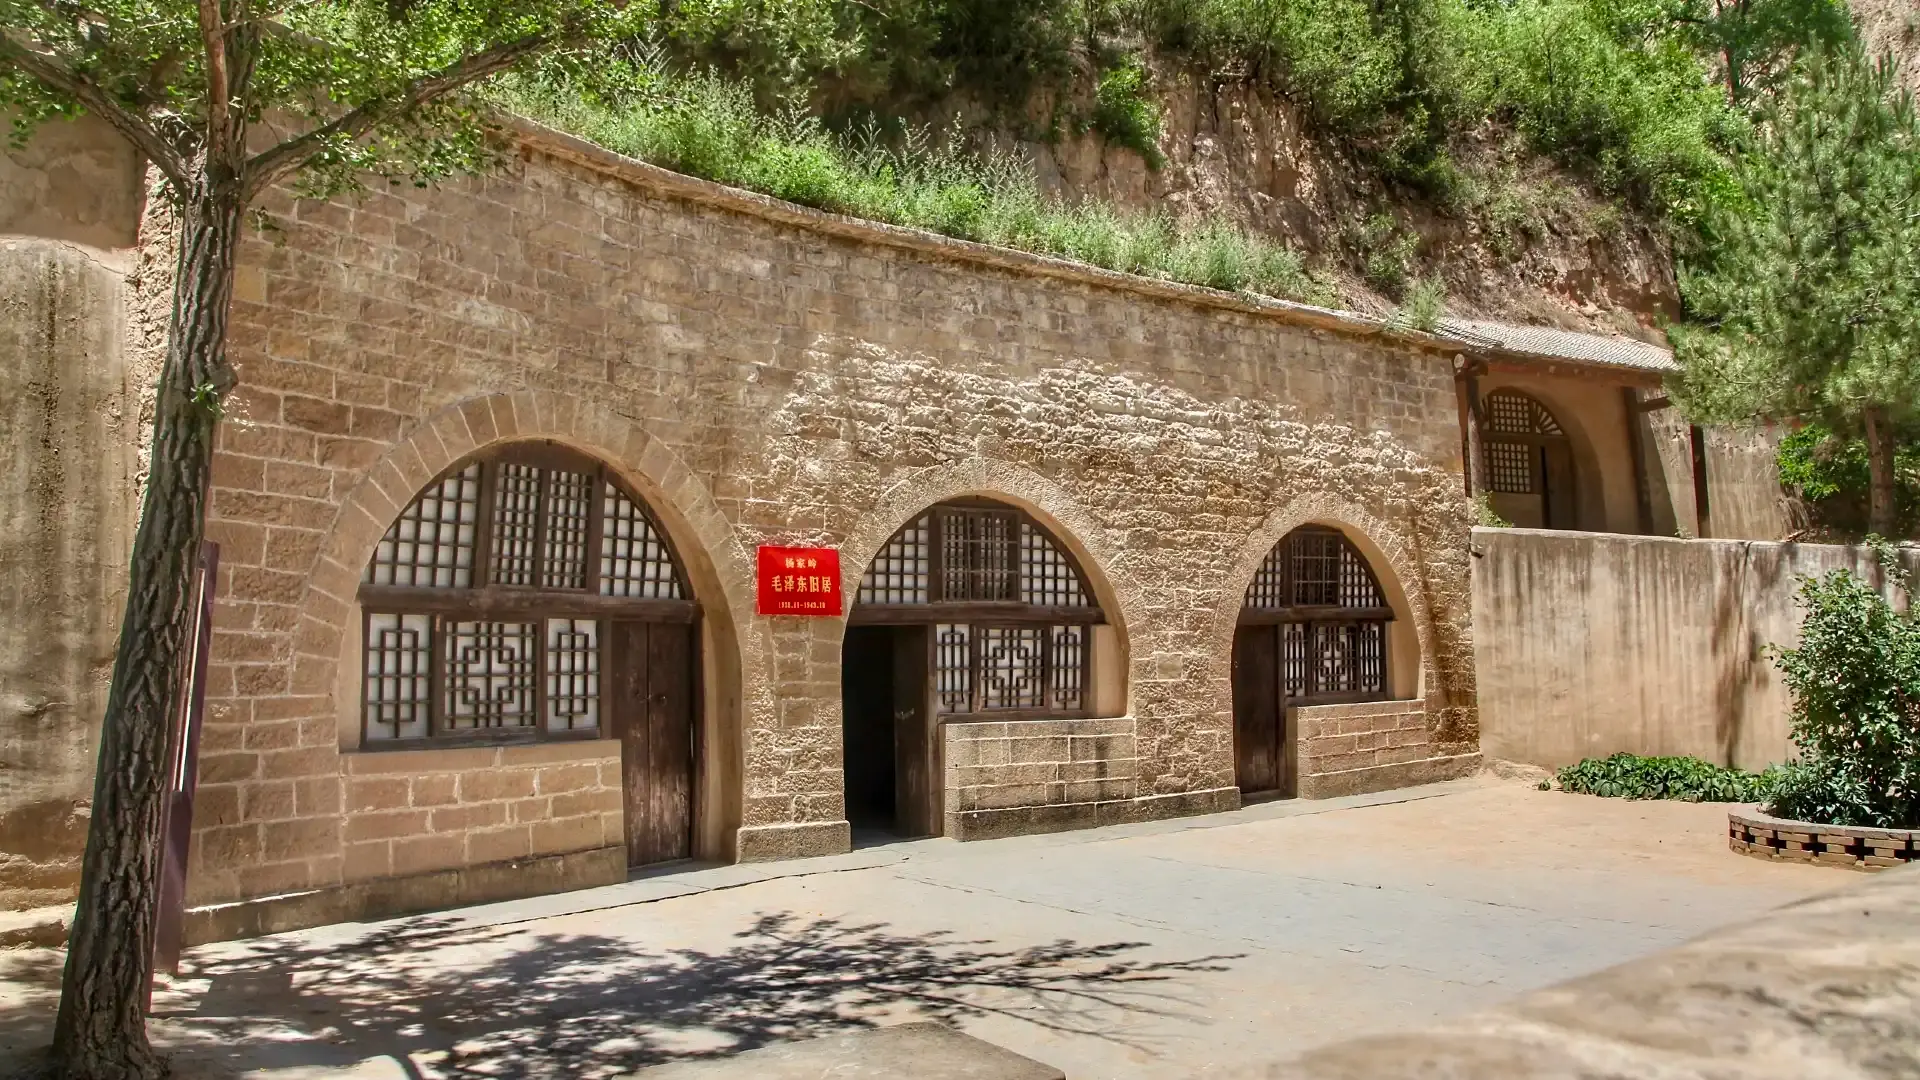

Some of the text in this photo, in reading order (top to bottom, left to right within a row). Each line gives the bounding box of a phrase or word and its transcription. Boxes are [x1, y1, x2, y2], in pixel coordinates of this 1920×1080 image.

[785, 557, 817, 569] 杨家岭
[771, 575, 832, 593] 毛泽东旧居
